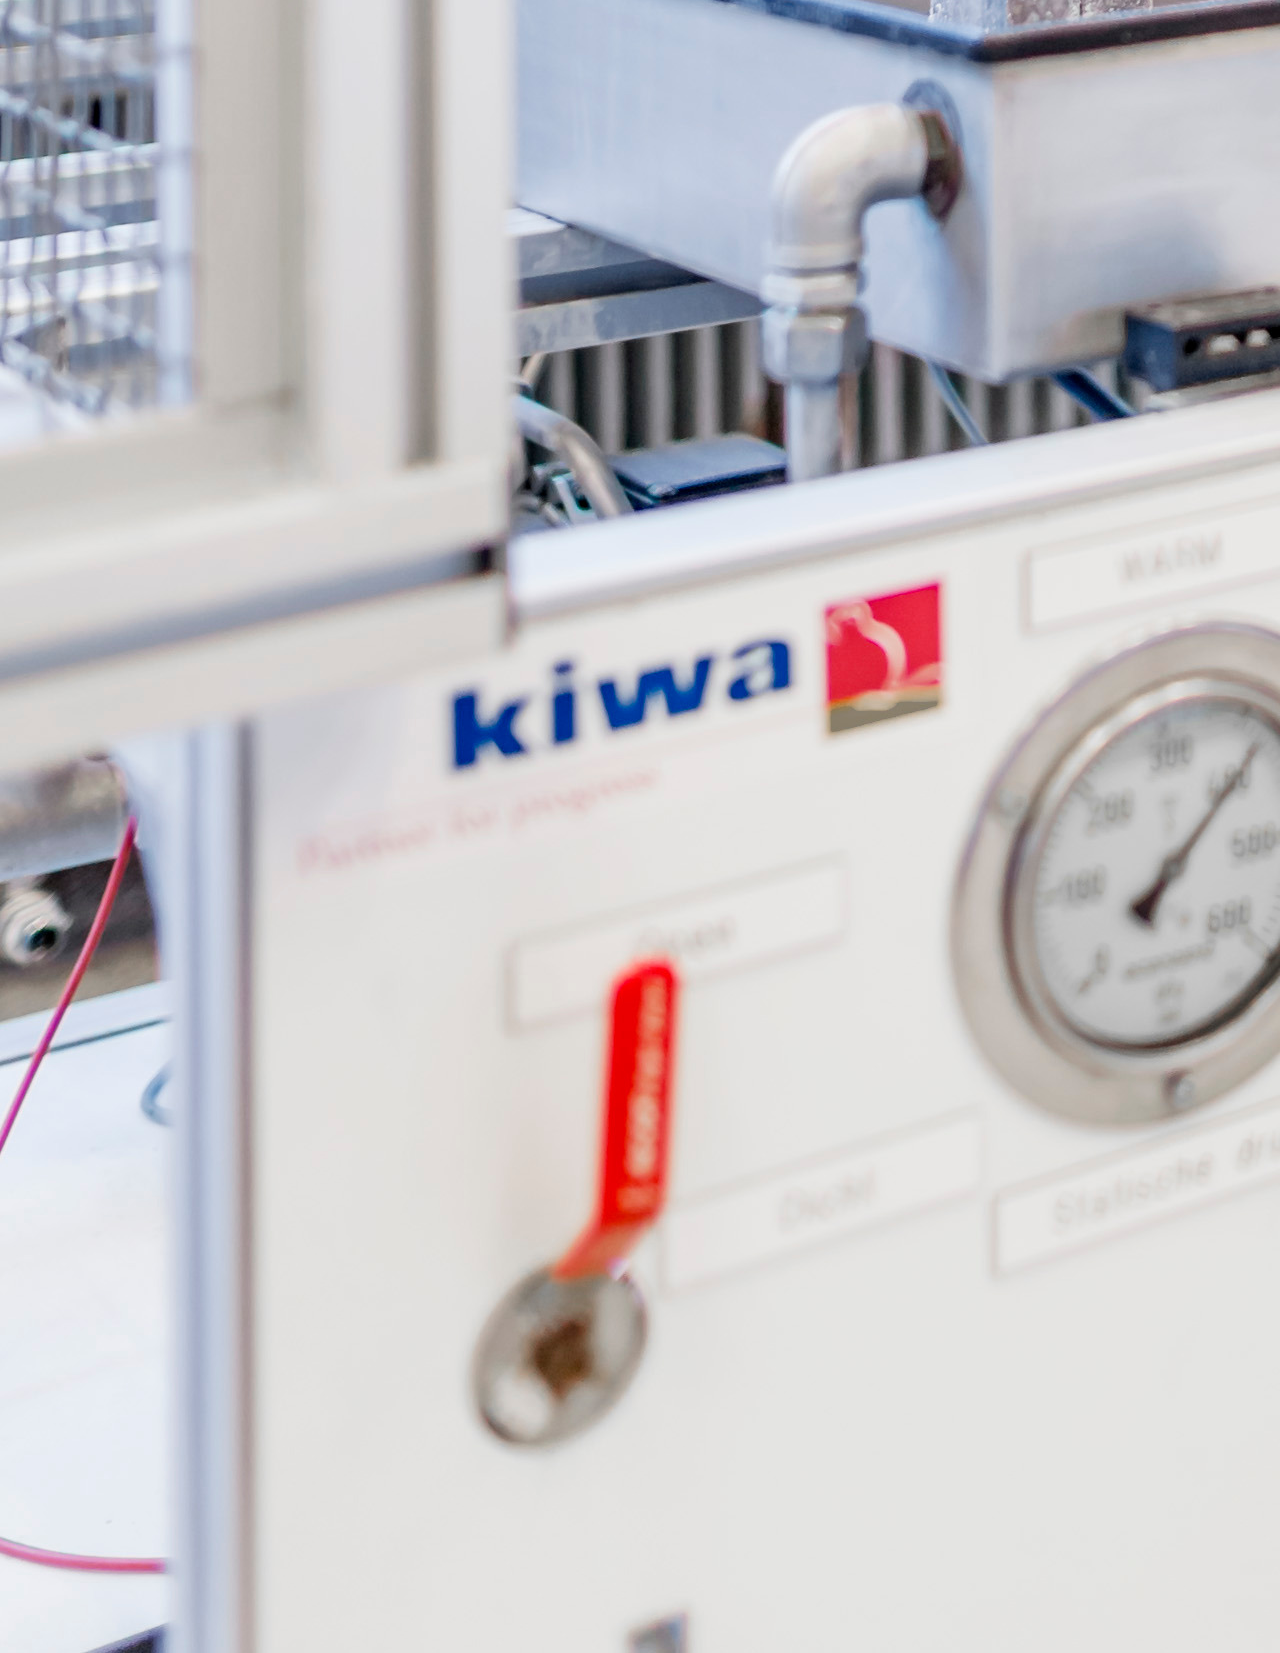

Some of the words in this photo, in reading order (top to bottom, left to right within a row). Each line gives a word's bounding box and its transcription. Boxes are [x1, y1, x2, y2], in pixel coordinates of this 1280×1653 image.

[1121, 531, 1224, 583] WARM
[453, 640, 792, 770] kiwa
[1149, 735, 1194, 772] 300
[1089, 790, 1135, 836] 200
[1231, 823, 1278, 864] 500
[1207, 898, 1253, 934] 600
[1052, 1152, 1213, 1234] Statische
